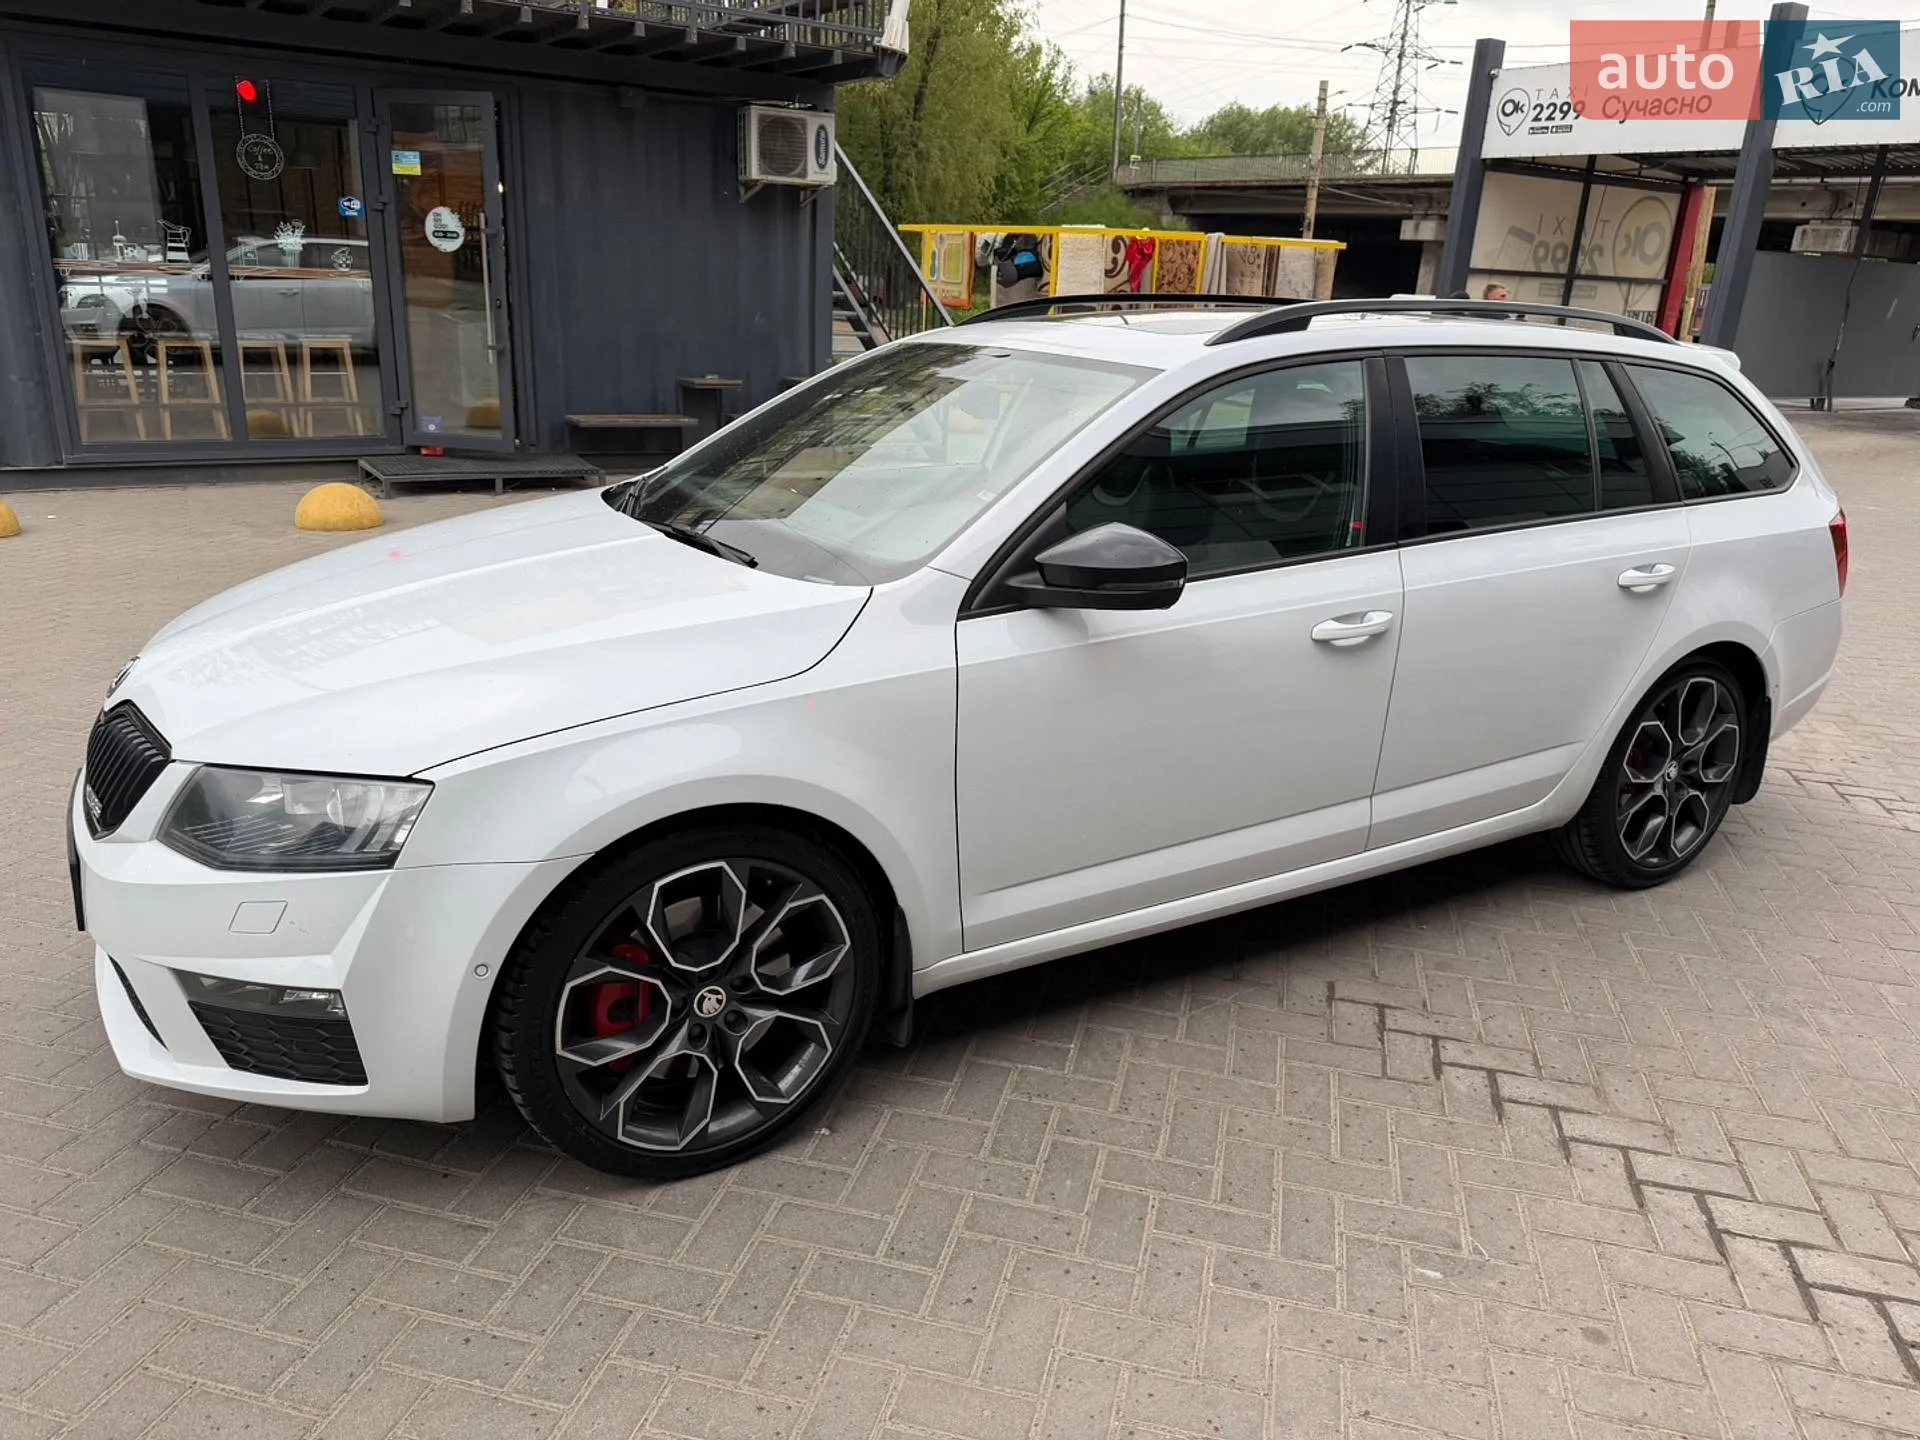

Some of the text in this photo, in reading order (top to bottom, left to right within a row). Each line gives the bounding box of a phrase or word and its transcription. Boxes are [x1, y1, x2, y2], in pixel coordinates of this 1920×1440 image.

[1535, 85, 1588, 100] TAXI
[1531, 100, 1586, 122] 2299
[1602, 94, 1713, 125] Сучасно
